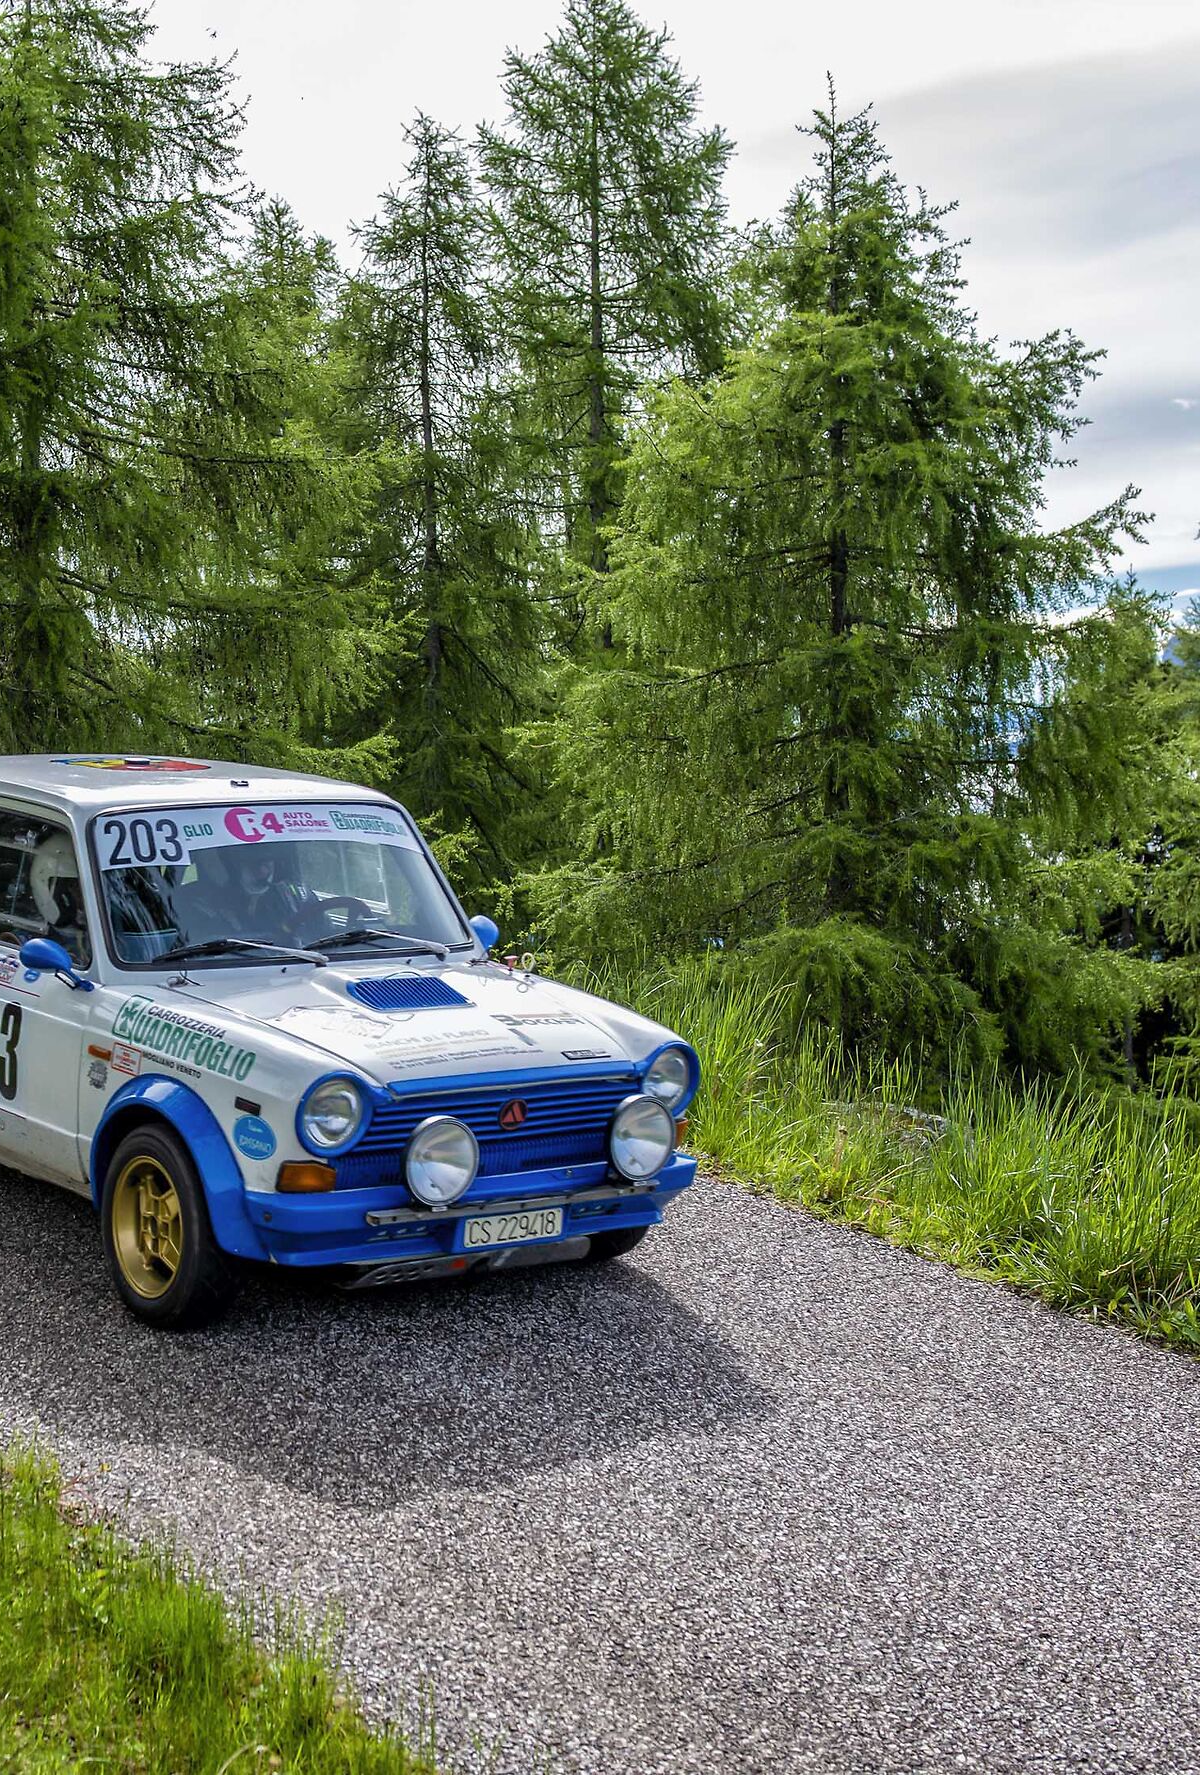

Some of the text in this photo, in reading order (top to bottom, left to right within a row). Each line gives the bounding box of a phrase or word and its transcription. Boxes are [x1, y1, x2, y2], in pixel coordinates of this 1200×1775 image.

[182, 822, 214, 838] GLIO
[283, 812, 312, 820] AUTO
[284, 819, 330, 828] SALONE
[103, 818, 183, 866] 203
[147, 1005, 227, 1040] CARROZZERIA
[142, 1050, 175, 1069] MOGLIANO
[176, 1063, 202, 1080] VENETO
[467, 1210, 557, 1245] CS 229418
